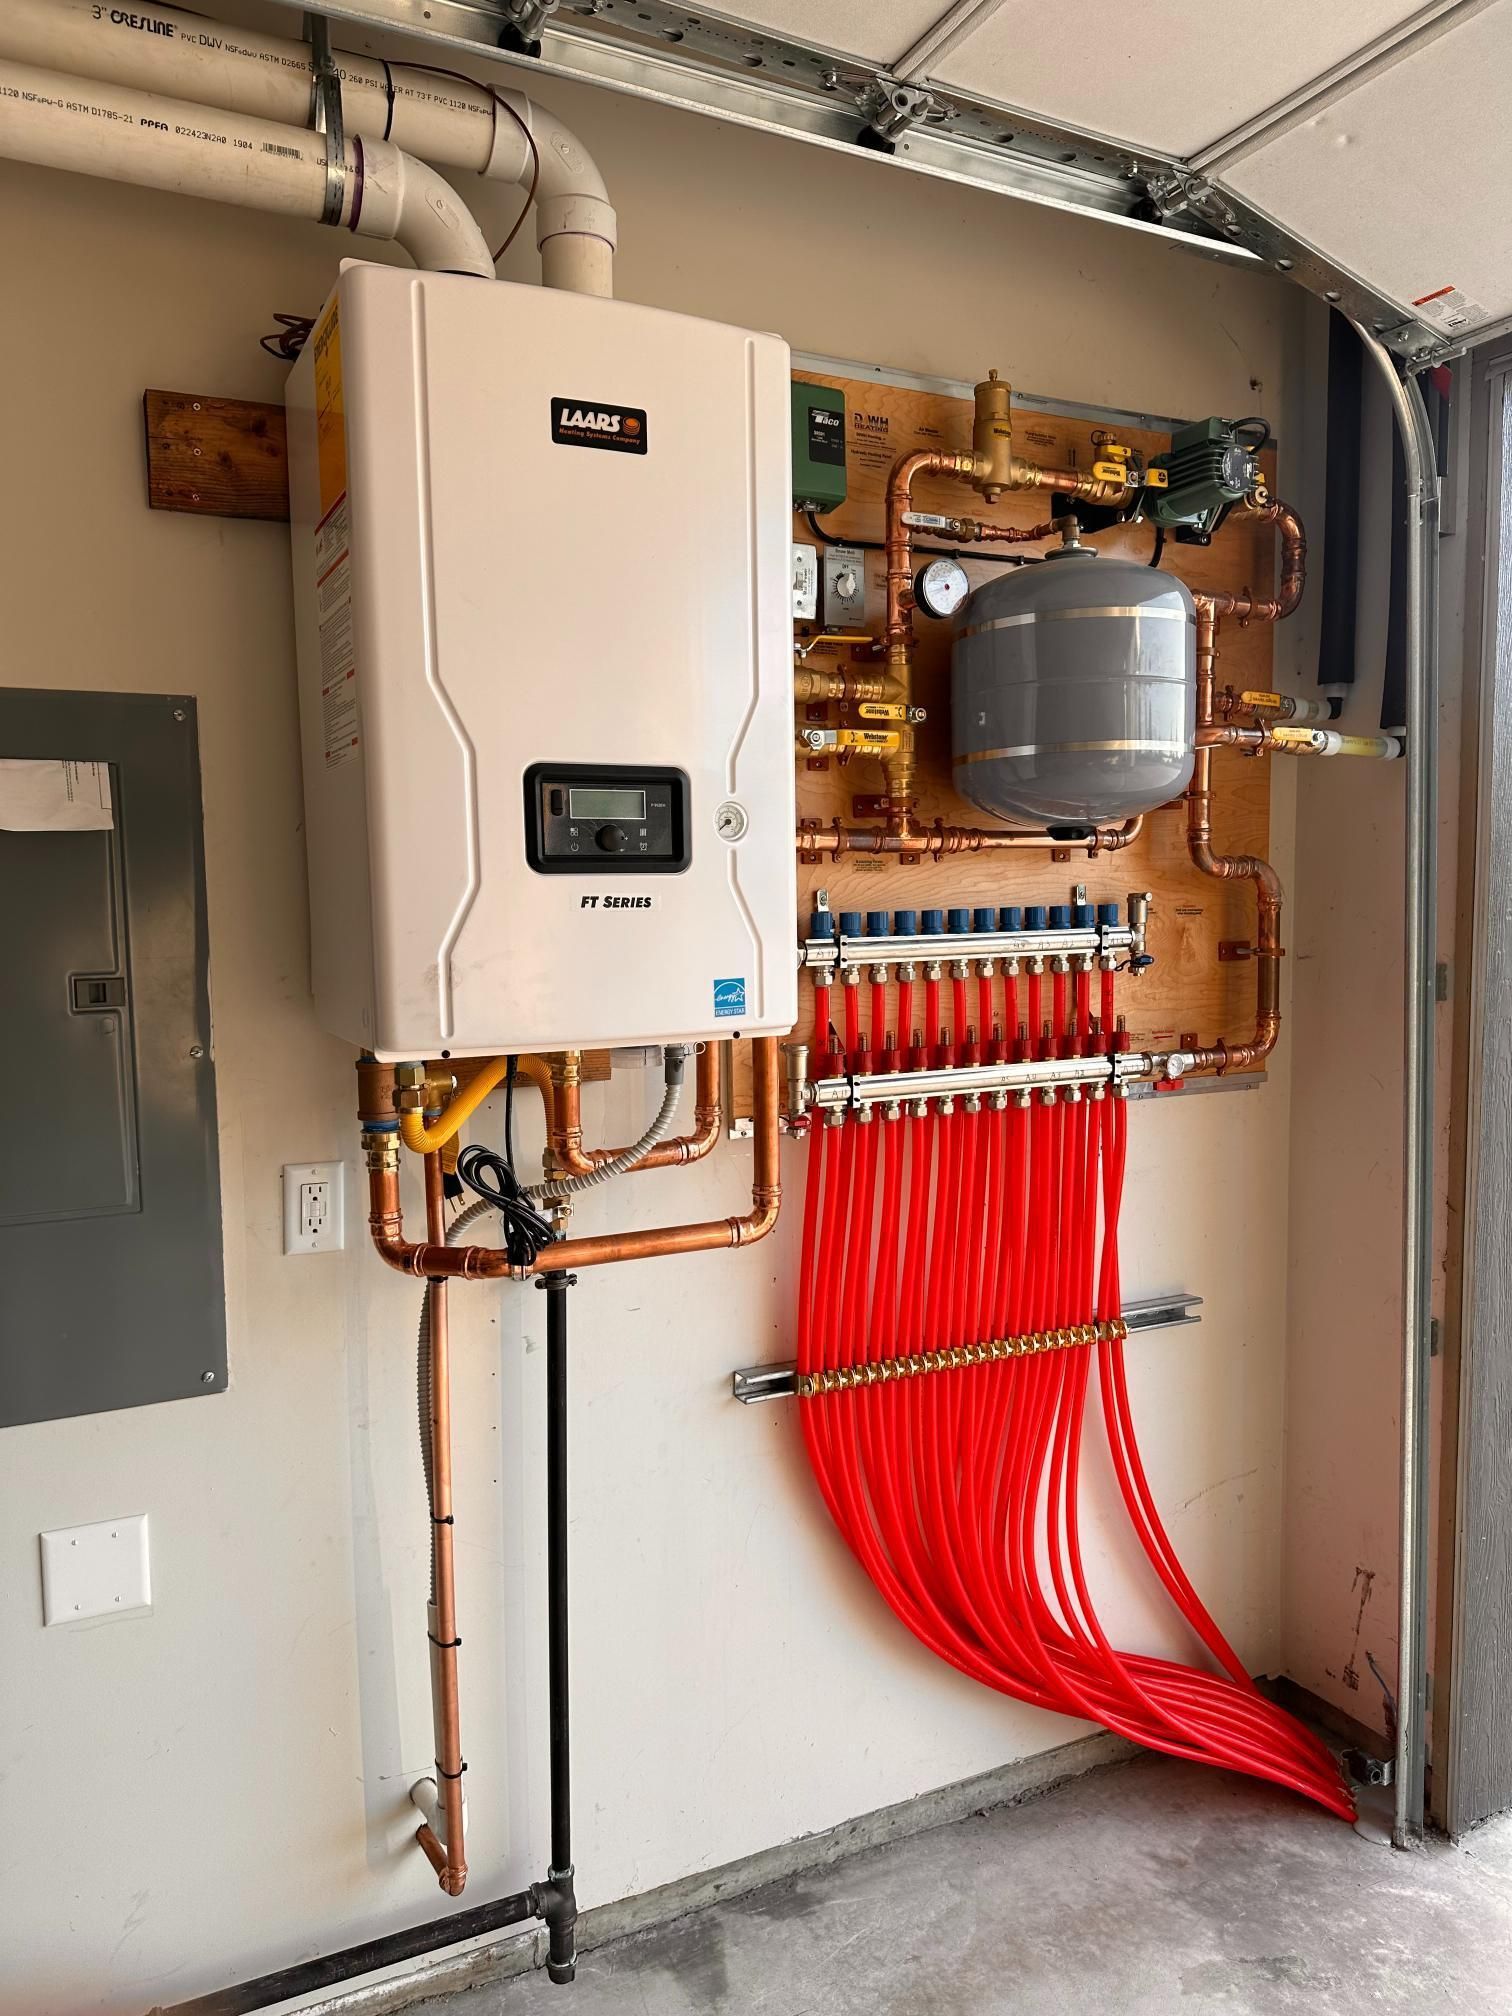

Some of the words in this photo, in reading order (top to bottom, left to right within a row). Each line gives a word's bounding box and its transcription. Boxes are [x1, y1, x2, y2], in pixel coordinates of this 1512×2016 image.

[110, 9, 175, 38] CRESLINE
[181, 33, 197, 43] PVC
[199, 34, 223, 49] DWV
[259, 54, 280, 64] ASTM
[365, 79, 378, 89] PSI
[405, 88, 414, 97] AT
[433, 96, 448, 105] PVC
[449, 99, 466, 110] 1120
[66, 101, 89, 113] ASTM
[91, 107, 134, 123] D1785-21
[140, 118, 169, 132] PPFA
[233, 138, 253, 150] 1904
[560, 408, 621, 433] LAARS
[559, 428, 585, 438] Heating
[586, 431, 612, 440] Systems
[612, 434, 641, 445] Company
[863, 732, 889, 741] Webstone
[580, 896, 599, 908] FT
[603, 896, 652, 909] SERIES
